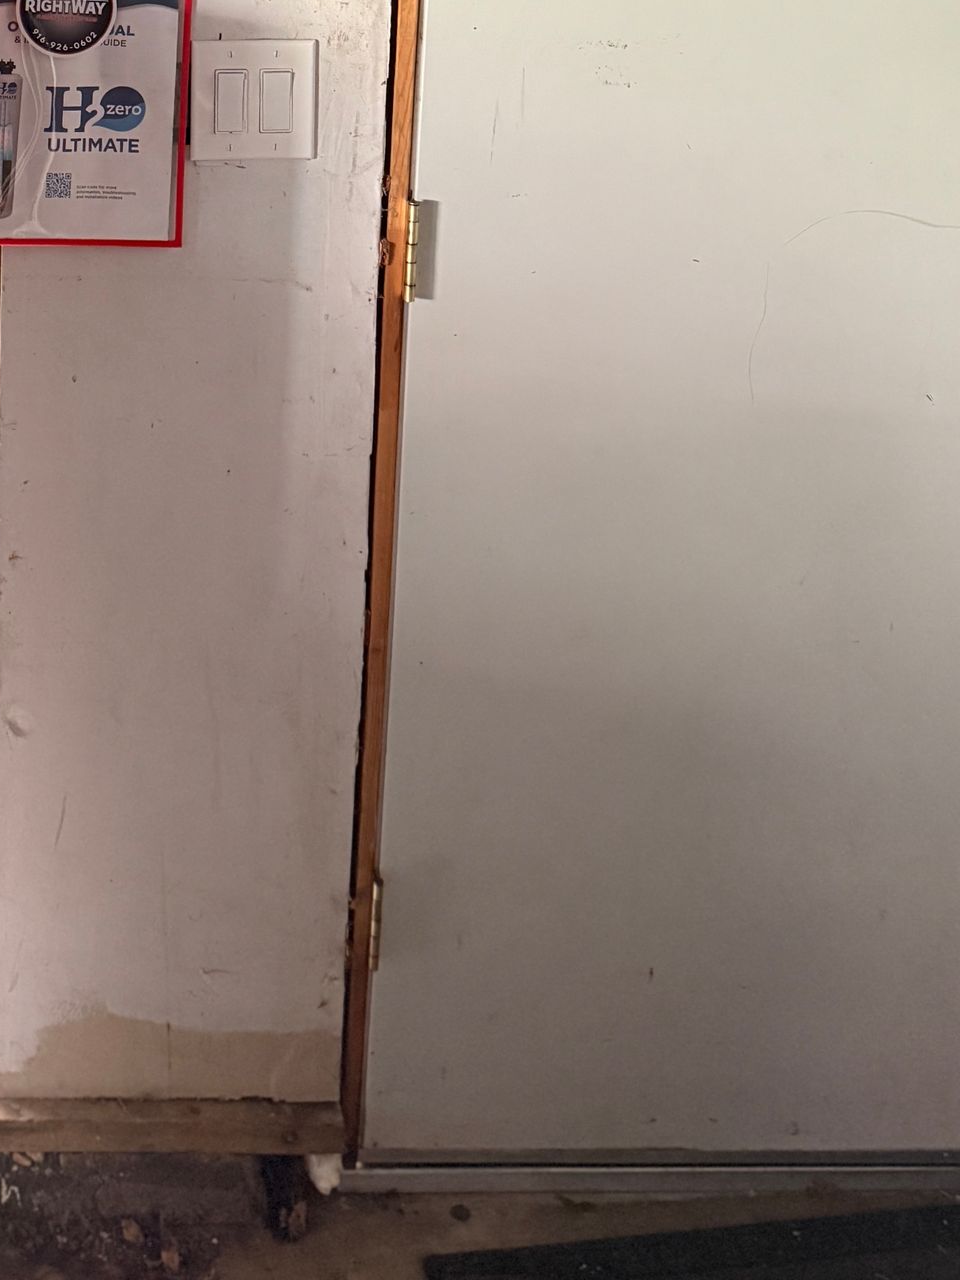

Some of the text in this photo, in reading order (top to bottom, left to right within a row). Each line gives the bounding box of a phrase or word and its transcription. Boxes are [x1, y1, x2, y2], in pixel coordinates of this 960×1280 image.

[32, 28, 98, 52] 916-926-0602
[100, 38, 127, 48] UIDE
[106, 102, 142, 117] zero
[48, 137, 140, 154] ULTIMATE
